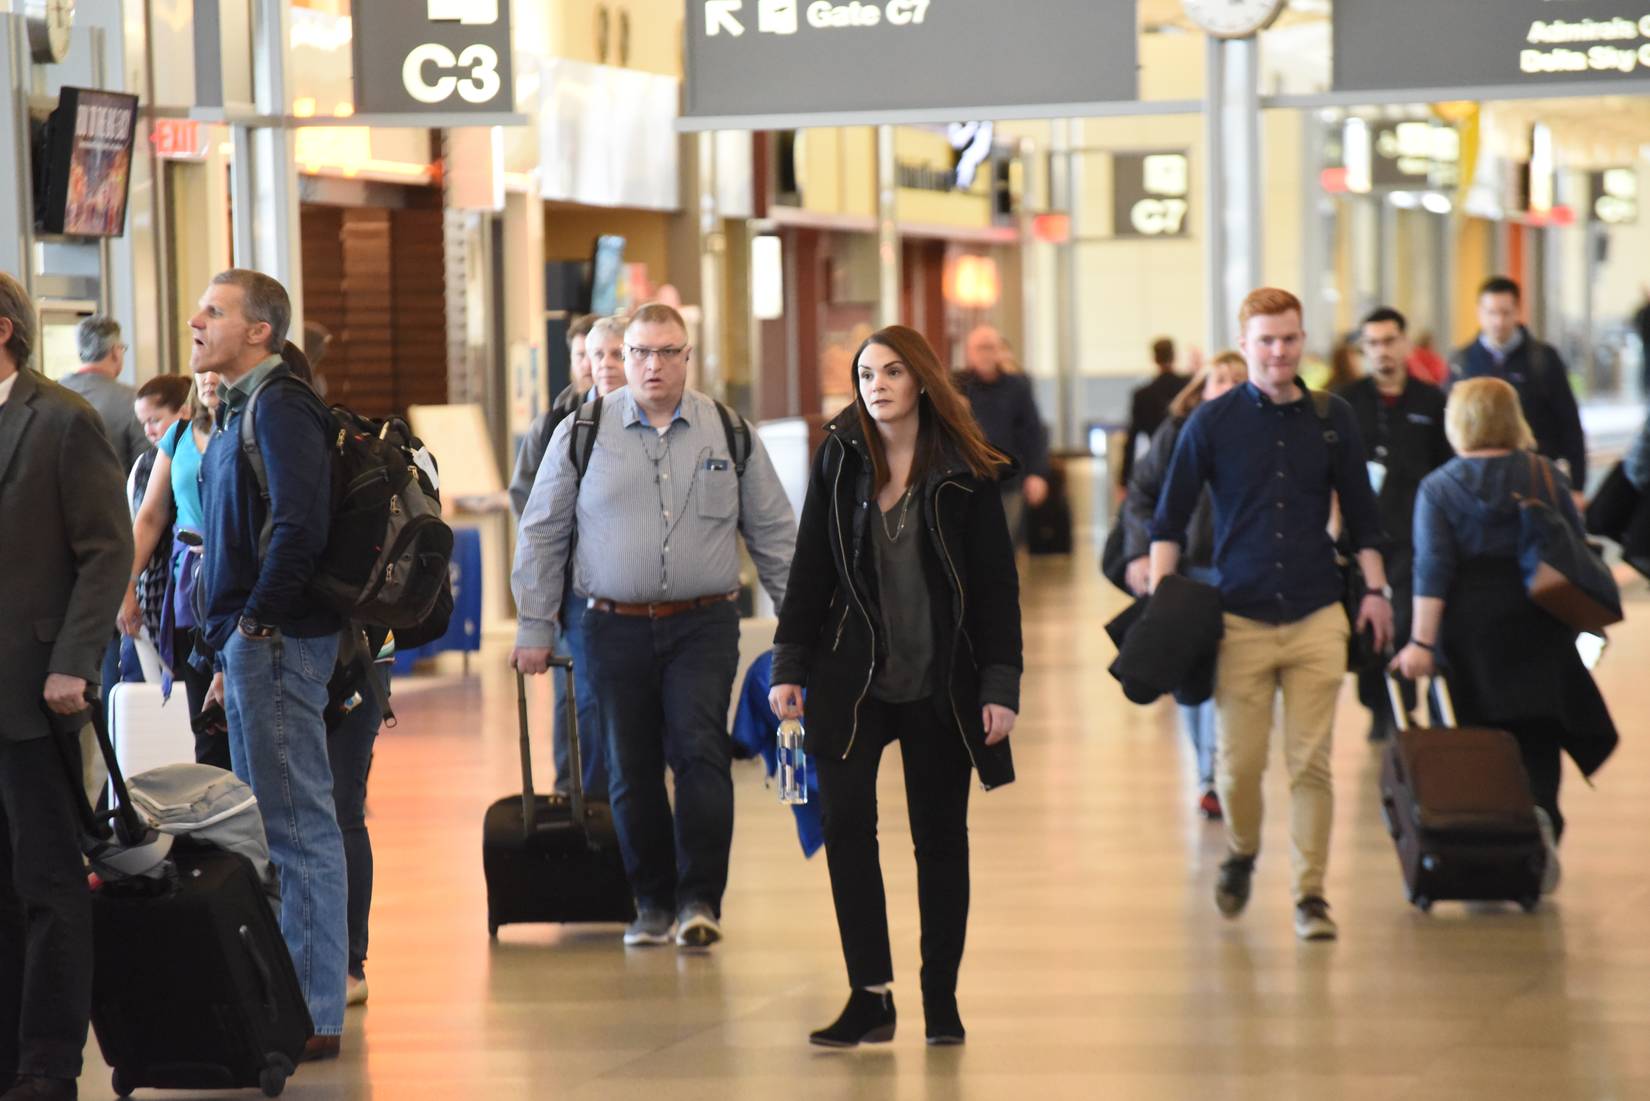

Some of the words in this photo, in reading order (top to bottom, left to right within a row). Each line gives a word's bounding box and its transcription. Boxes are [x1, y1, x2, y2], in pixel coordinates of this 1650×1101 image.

[806, 0, 881, 28] Gate
[885, 0, 931, 25] C7
[1526, 16, 1638, 44] Admirals
[402, 43, 501, 103] C3
[1520, 47, 1588, 73] Delta
[1587, 45, 1637, 72] Sky
[157, 119, 198, 153] EXIT
[1130, 198, 1188, 235] C7
